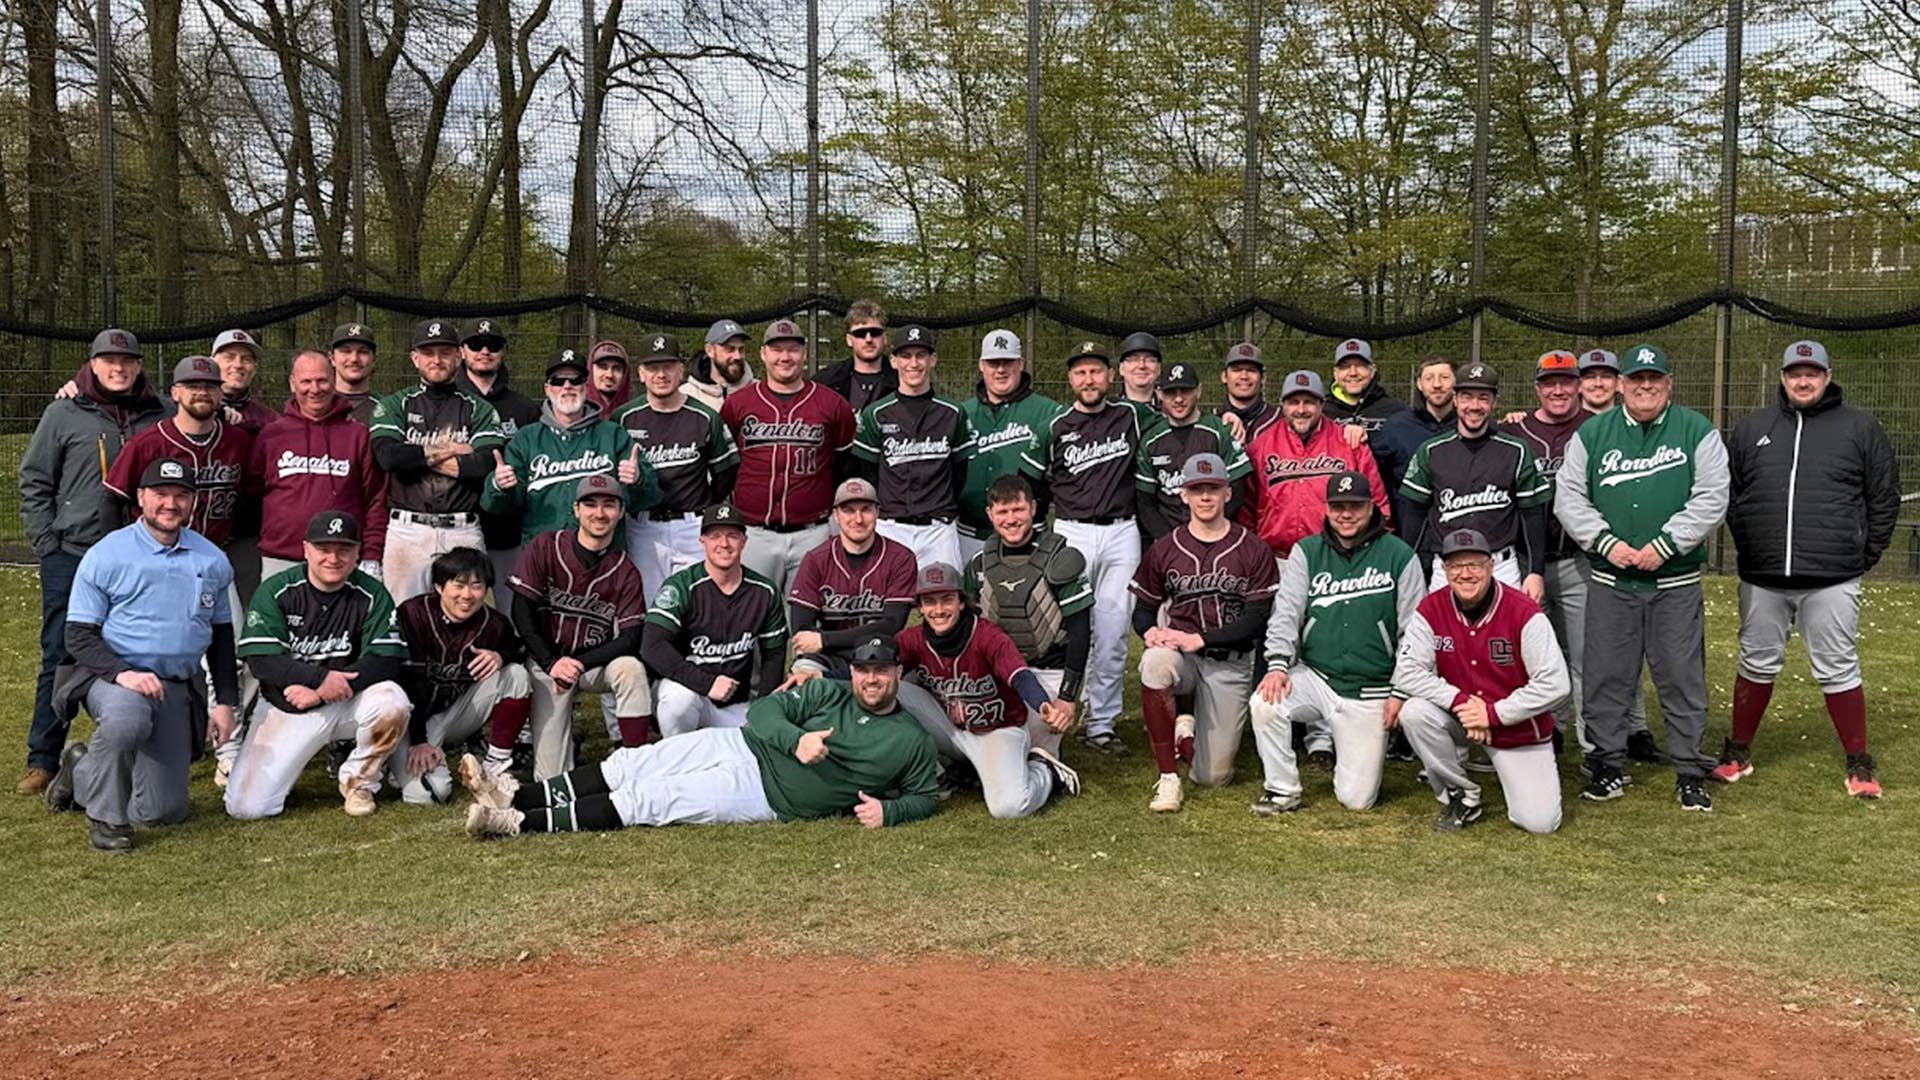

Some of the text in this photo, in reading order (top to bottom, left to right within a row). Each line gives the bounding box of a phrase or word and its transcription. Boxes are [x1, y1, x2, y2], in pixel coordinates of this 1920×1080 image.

[742, 415, 825, 446] Senators
[277, 450, 350, 474] Senators
[529, 450, 614, 482] Rowdies
[794, 447, 817, 474] 11
[1598, 445, 1687, 476] Rowdies
[1439, 485, 1512, 514] Rowdies
[1308, 567, 1395, 600] Rowdies
[820, 586, 886, 616] Senator
[965, 699, 1005, 727] 27
